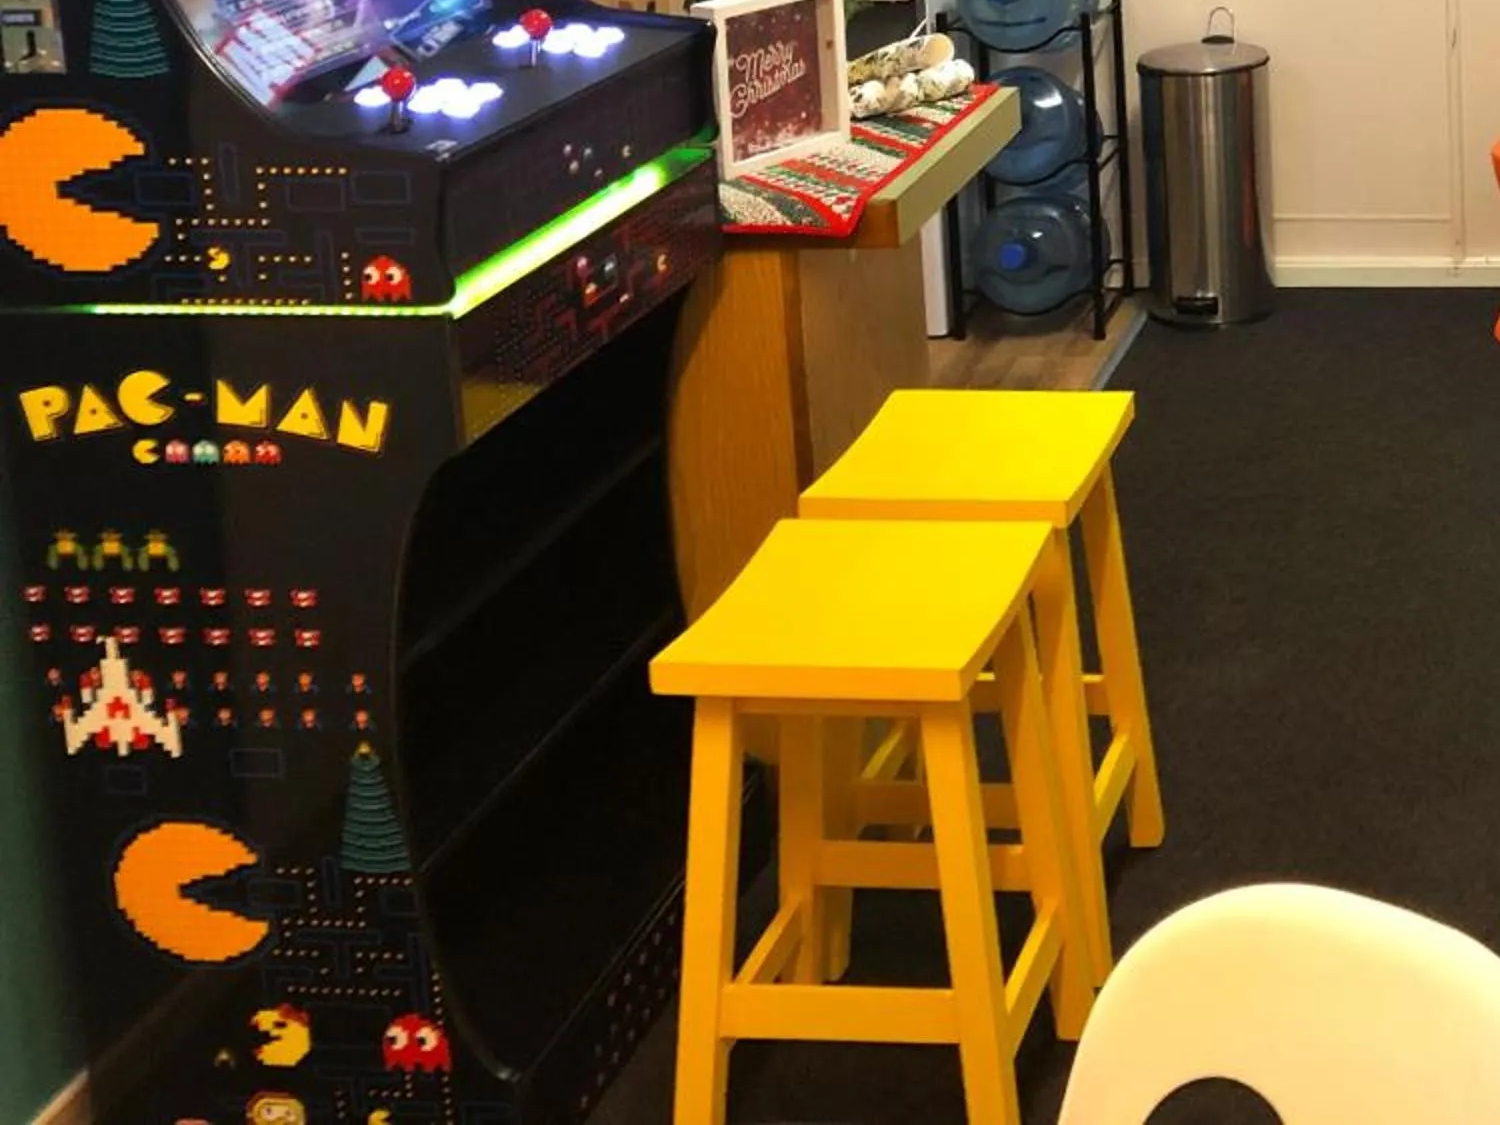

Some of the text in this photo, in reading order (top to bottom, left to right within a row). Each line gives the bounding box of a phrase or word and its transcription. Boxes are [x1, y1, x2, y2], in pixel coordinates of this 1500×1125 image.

[729, 59, 807, 119] Christmas
[735, 40, 797, 80] Merry
[19, 369, 389, 454] PAC-MAN
